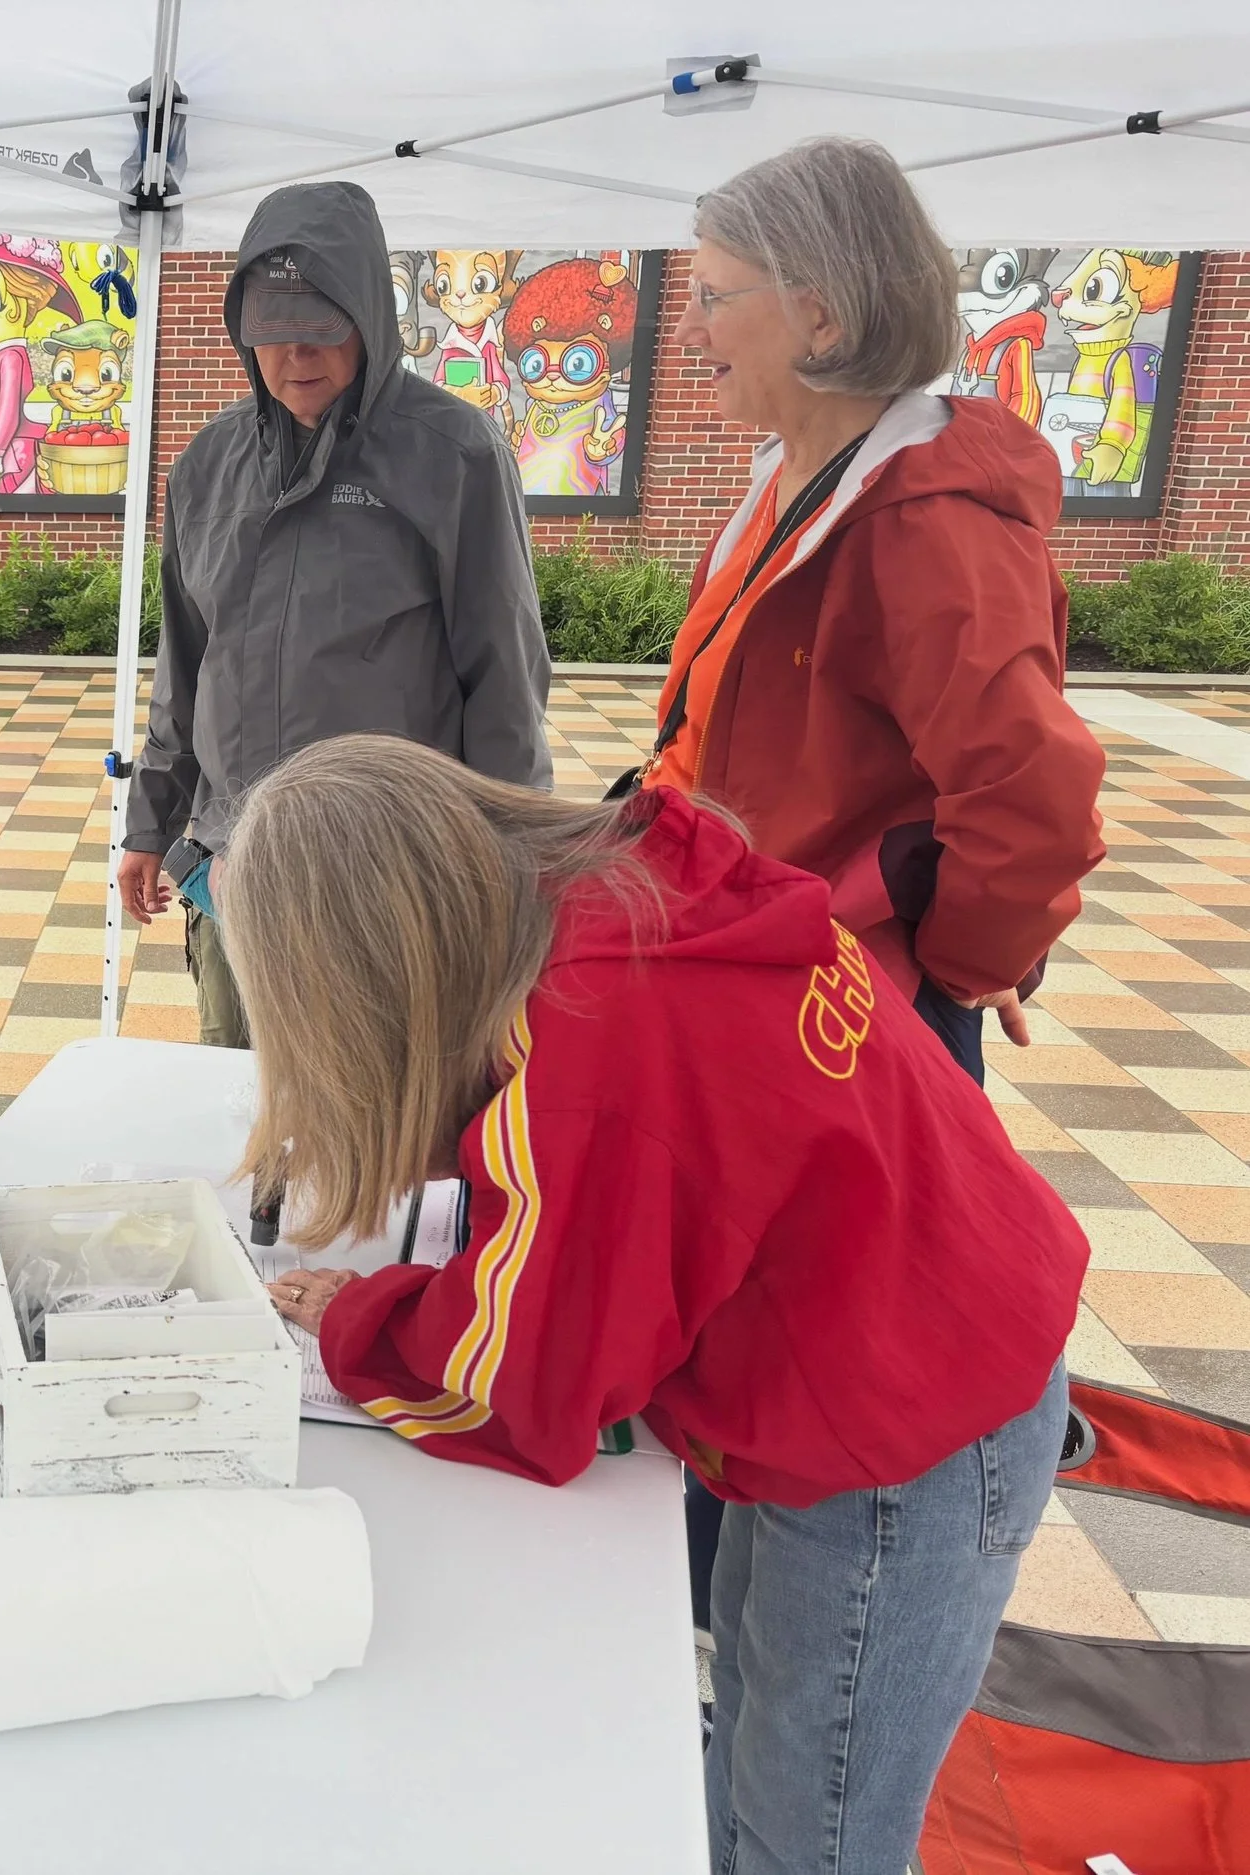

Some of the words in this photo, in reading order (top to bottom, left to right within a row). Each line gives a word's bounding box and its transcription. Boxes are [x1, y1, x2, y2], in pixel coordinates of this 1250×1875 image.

[269, 270, 287, 279] MAIN
[334, 484, 362, 495] EDDIE
[332, 494, 365, 505] BAUER
